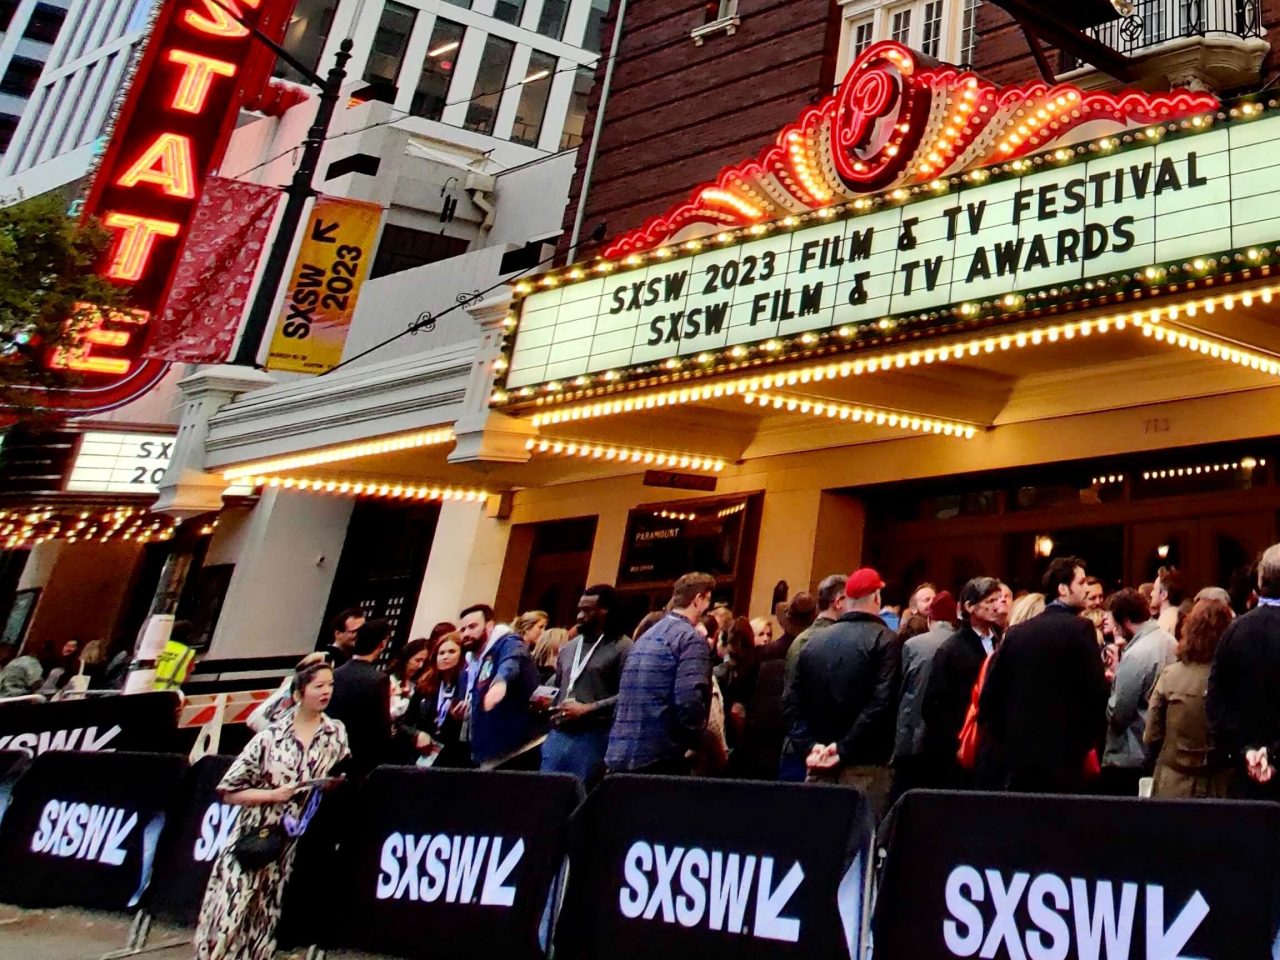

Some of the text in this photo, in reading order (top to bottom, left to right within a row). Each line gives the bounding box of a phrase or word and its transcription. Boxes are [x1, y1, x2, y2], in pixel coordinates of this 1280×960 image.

[609, 152, 1207, 314] SXSW 2023 FILM & TV FESTIVAL
[282, 263, 326, 340] SXSW
[321, 244, 362, 311] 2023
[647, 215, 1135, 346] SXSW FILM & TV AWARDS
[130, 466, 166, 484] 20
[136, 441, 172, 460] SX
[635, 528, 680, 542] PARAMOUNT
[31, 799, 115, 861] SXSW
[194, 802, 242, 861] SX
[376, 832, 488, 904] SXSW
[619, 841, 756, 935] SXSW
[943, 865, 1138, 960] SXSW
